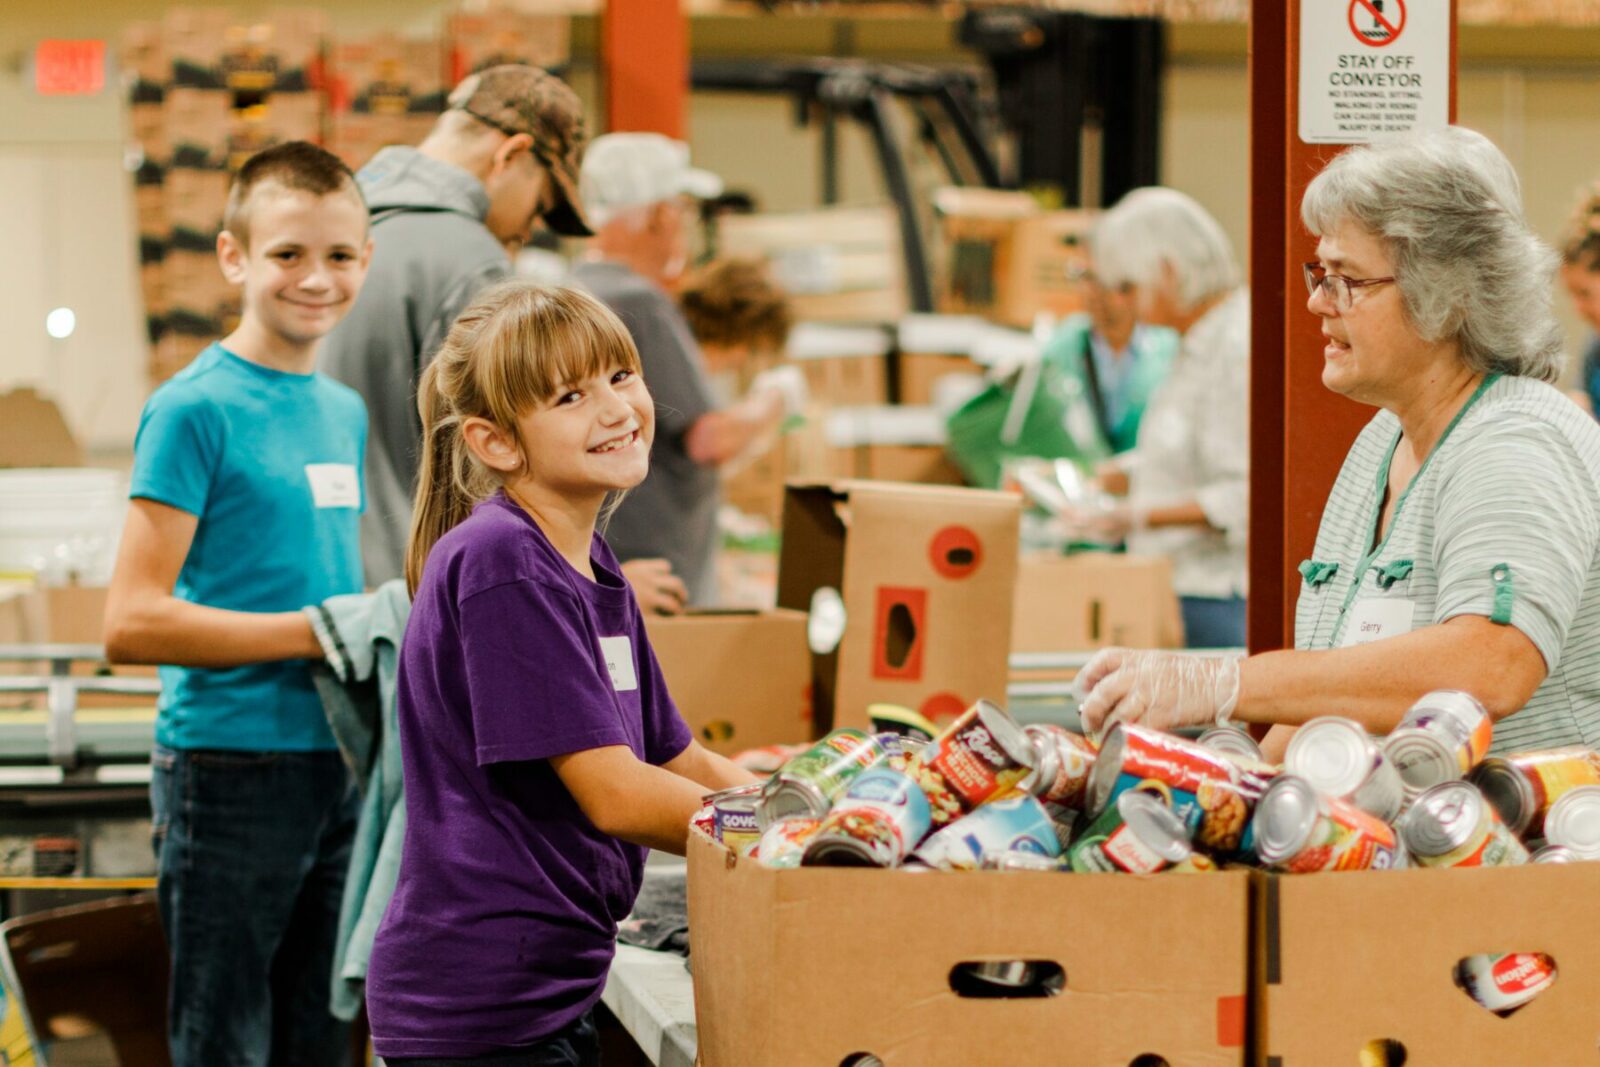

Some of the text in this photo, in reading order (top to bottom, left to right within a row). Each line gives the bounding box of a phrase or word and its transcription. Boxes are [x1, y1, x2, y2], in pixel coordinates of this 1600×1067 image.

[1337, 55, 1415, 70] STAY OFF
[1329, 72, 1422, 87] CONVEYOR
[1328, 90, 1341, 98] NO
[1375, 102, 1386, 110] OR
[1389, 102, 1417, 110] RIDING
[1334, 112, 1416, 121] CAN CAUSE SEVERE
[1339, 124, 1412, 132] INJURY OR DEATH
